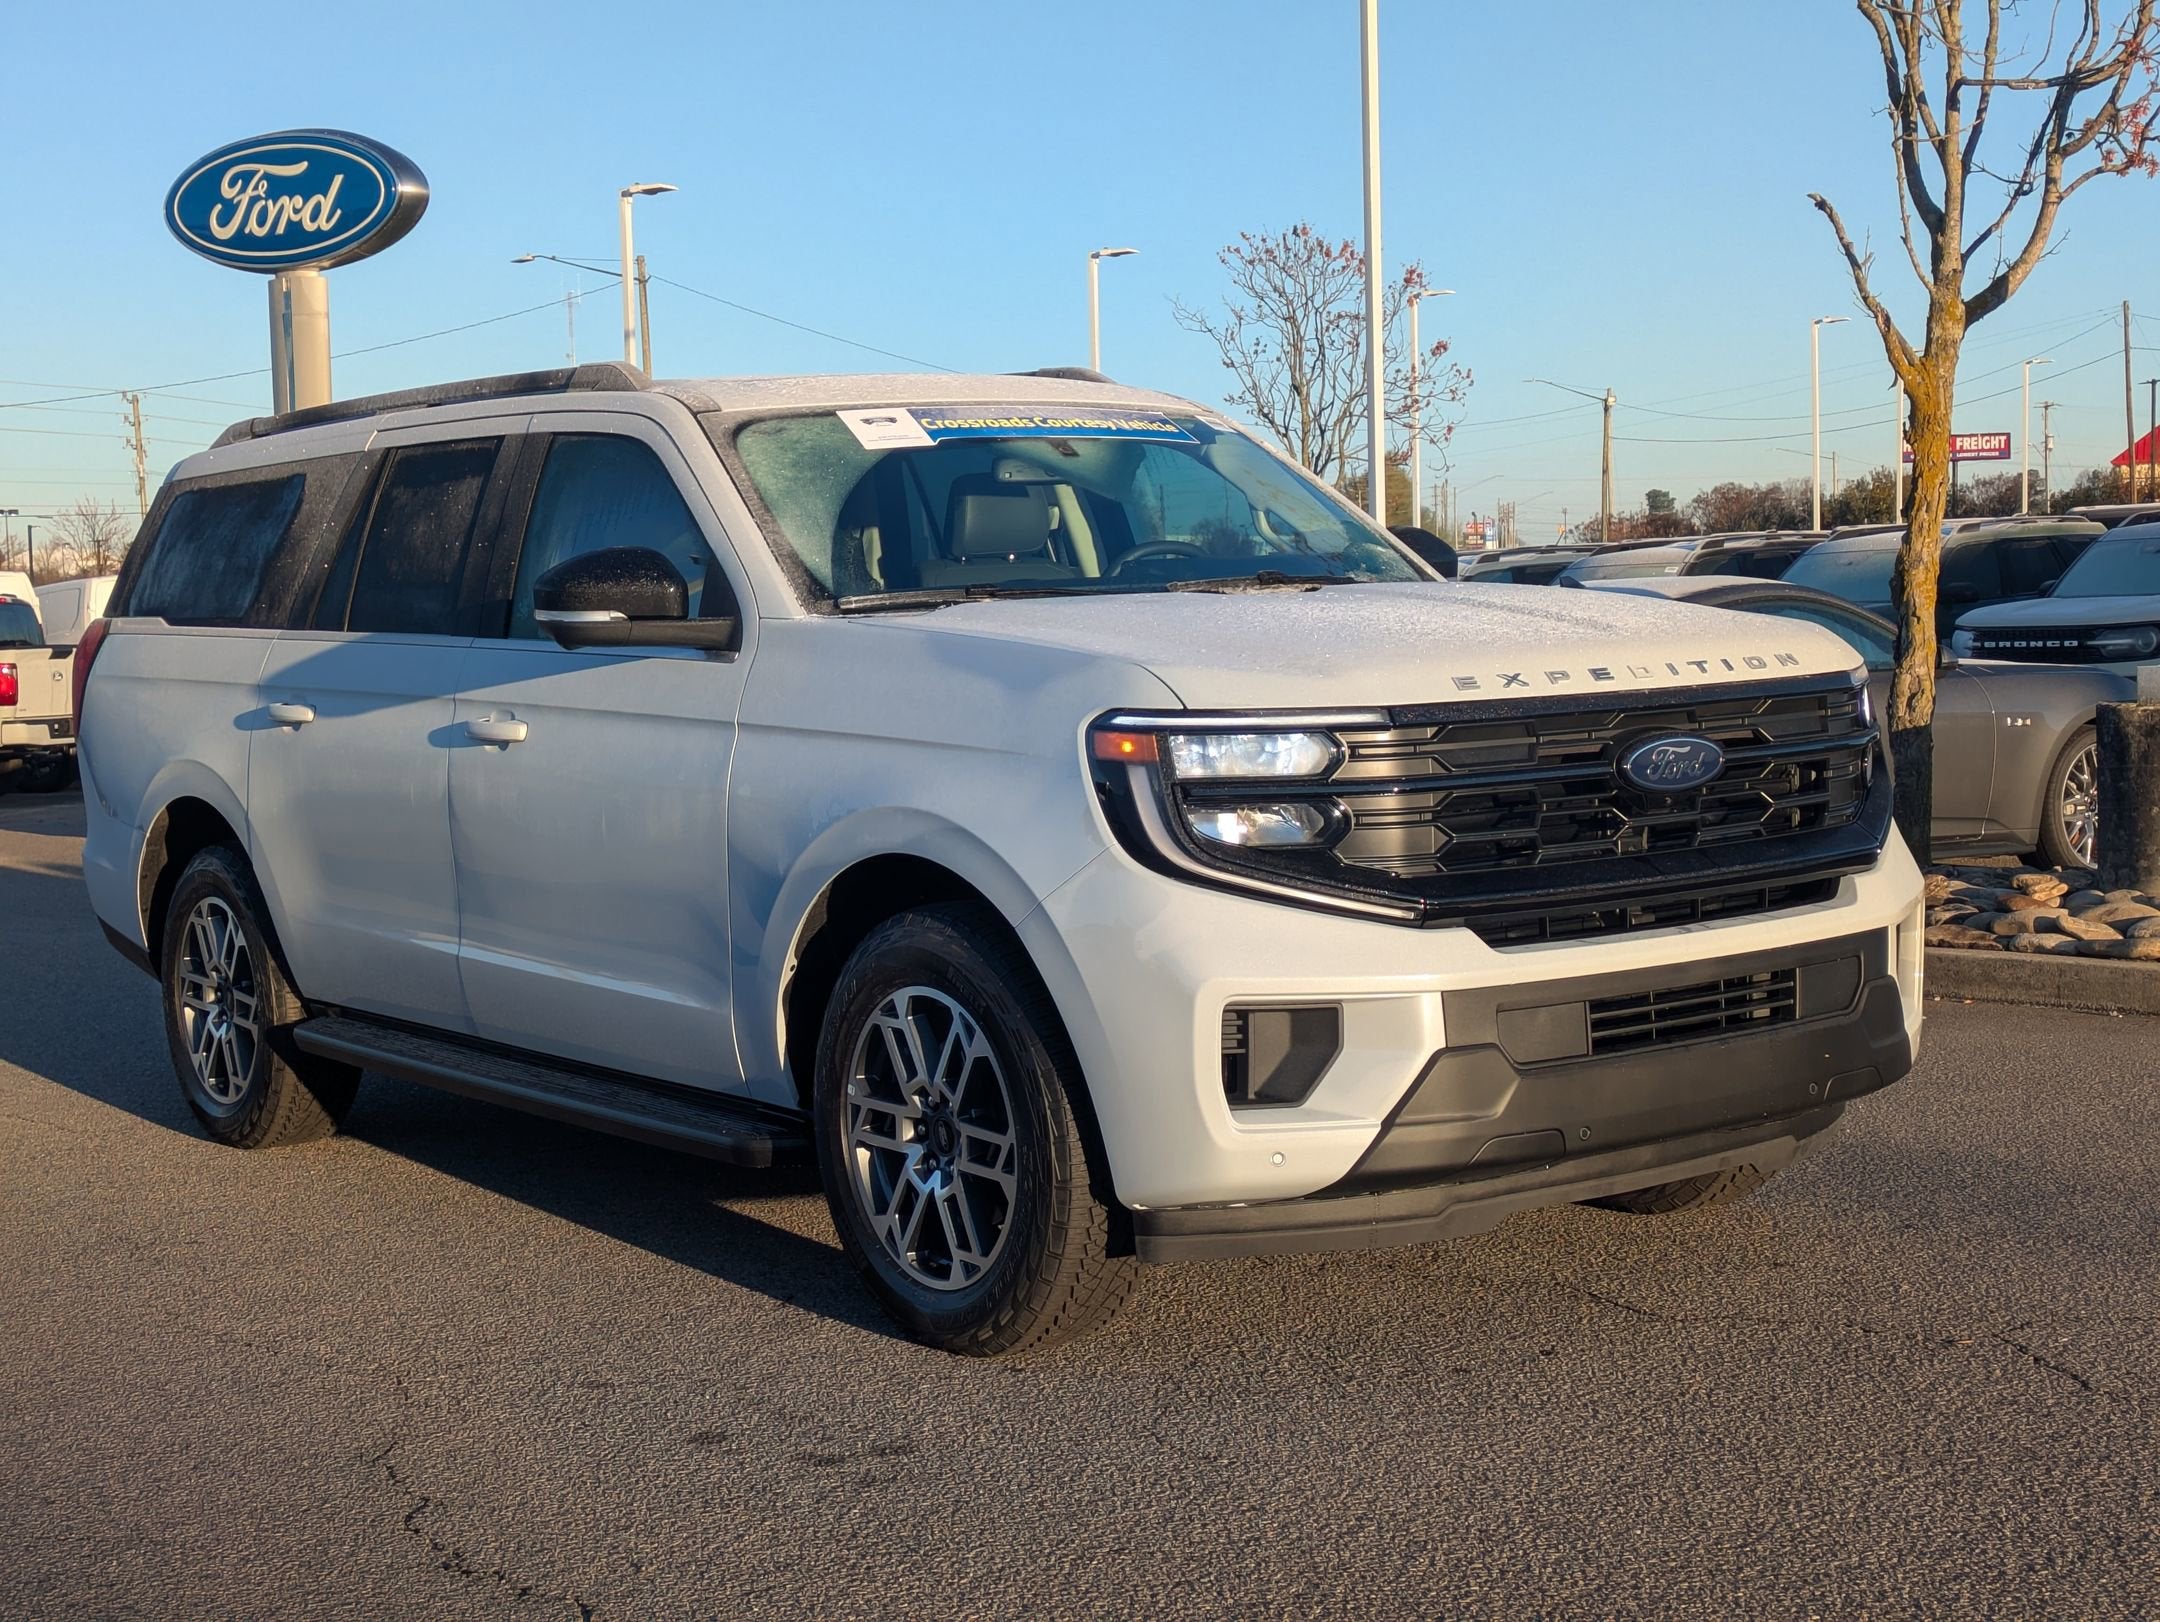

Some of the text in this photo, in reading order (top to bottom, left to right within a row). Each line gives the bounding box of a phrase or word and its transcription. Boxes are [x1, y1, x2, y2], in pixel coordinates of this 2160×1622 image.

[209, 160, 344, 240] Ford
[920, 416, 1180, 433] Crossroads Courtesy Vehicle
[1956, 434, 2007, 451] FREIGHT
[1983, 640, 2079, 648] BRONCO
[1451, 652, 1801, 692] EXPEDITION
[1646, 745, 1706, 781] Ford
